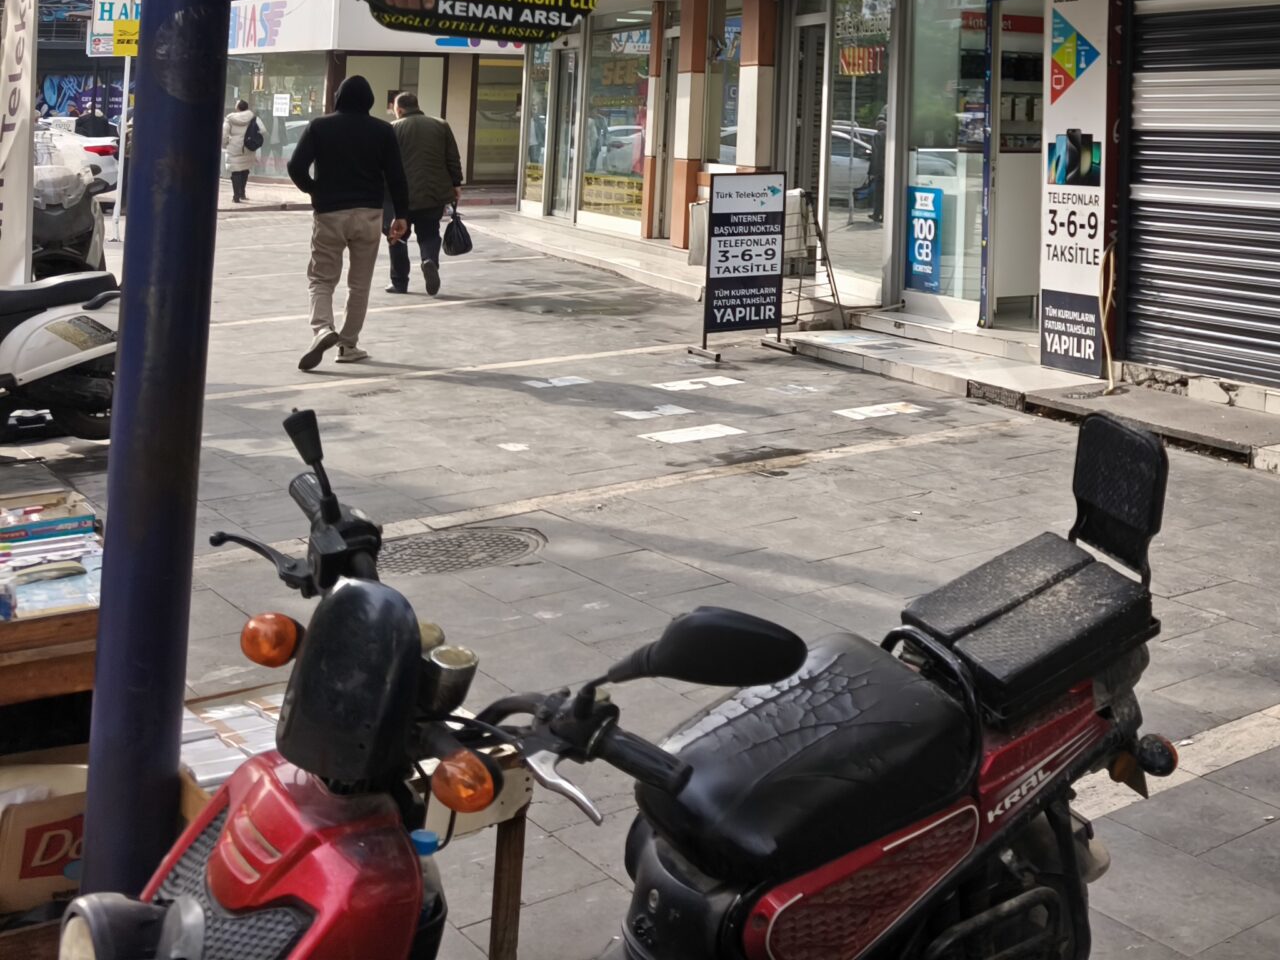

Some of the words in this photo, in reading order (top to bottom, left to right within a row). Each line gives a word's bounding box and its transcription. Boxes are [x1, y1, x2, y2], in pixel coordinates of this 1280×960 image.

[438, 0, 518, 21] KENAN
[519, 8, 583, 27] ARSLA
[716, 191, 733, 199] Türk
[736, 191, 768, 199] Telekom
[1047, 191, 1100, 206] TELEFONLAR
[730, 214, 766, 223] İNTERNET
[1048, 209, 1099, 240] 3-6-9
[714, 225, 749, 236] BAŞVURU
[750, 224, 781, 233] NOKTASI
[912, 218, 935, 241] 100
[717, 238, 777, 248] TELEFONLAR
[914, 240, 932, 261] GB
[718, 248, 776, 263] 3-6-9
[1046, 243, 1100, 266] TAKSİTLE
[715, 262, 778, 275] TAKSİTLE
[714, 288, 730, 297] TÜM
[731, 286, 777, 296] KURUMLARIN
[713, 298, 741, 306] FATURA
[742, 296, 777, 305] TAHSİLATI
[713, 305, 776, 323] YAPILIR
[1045, 305, 1058, 317] TÜM
[1058, 309, 1096, 323] KURUMLARIN
[1044, 319, 1066, 332] FATURA
[1066, 322, 1096, 337] TAHSİLATI
[1044, 332, 1095, 360] YAPILIR
[987, 769, 1051, 824] KRAL
